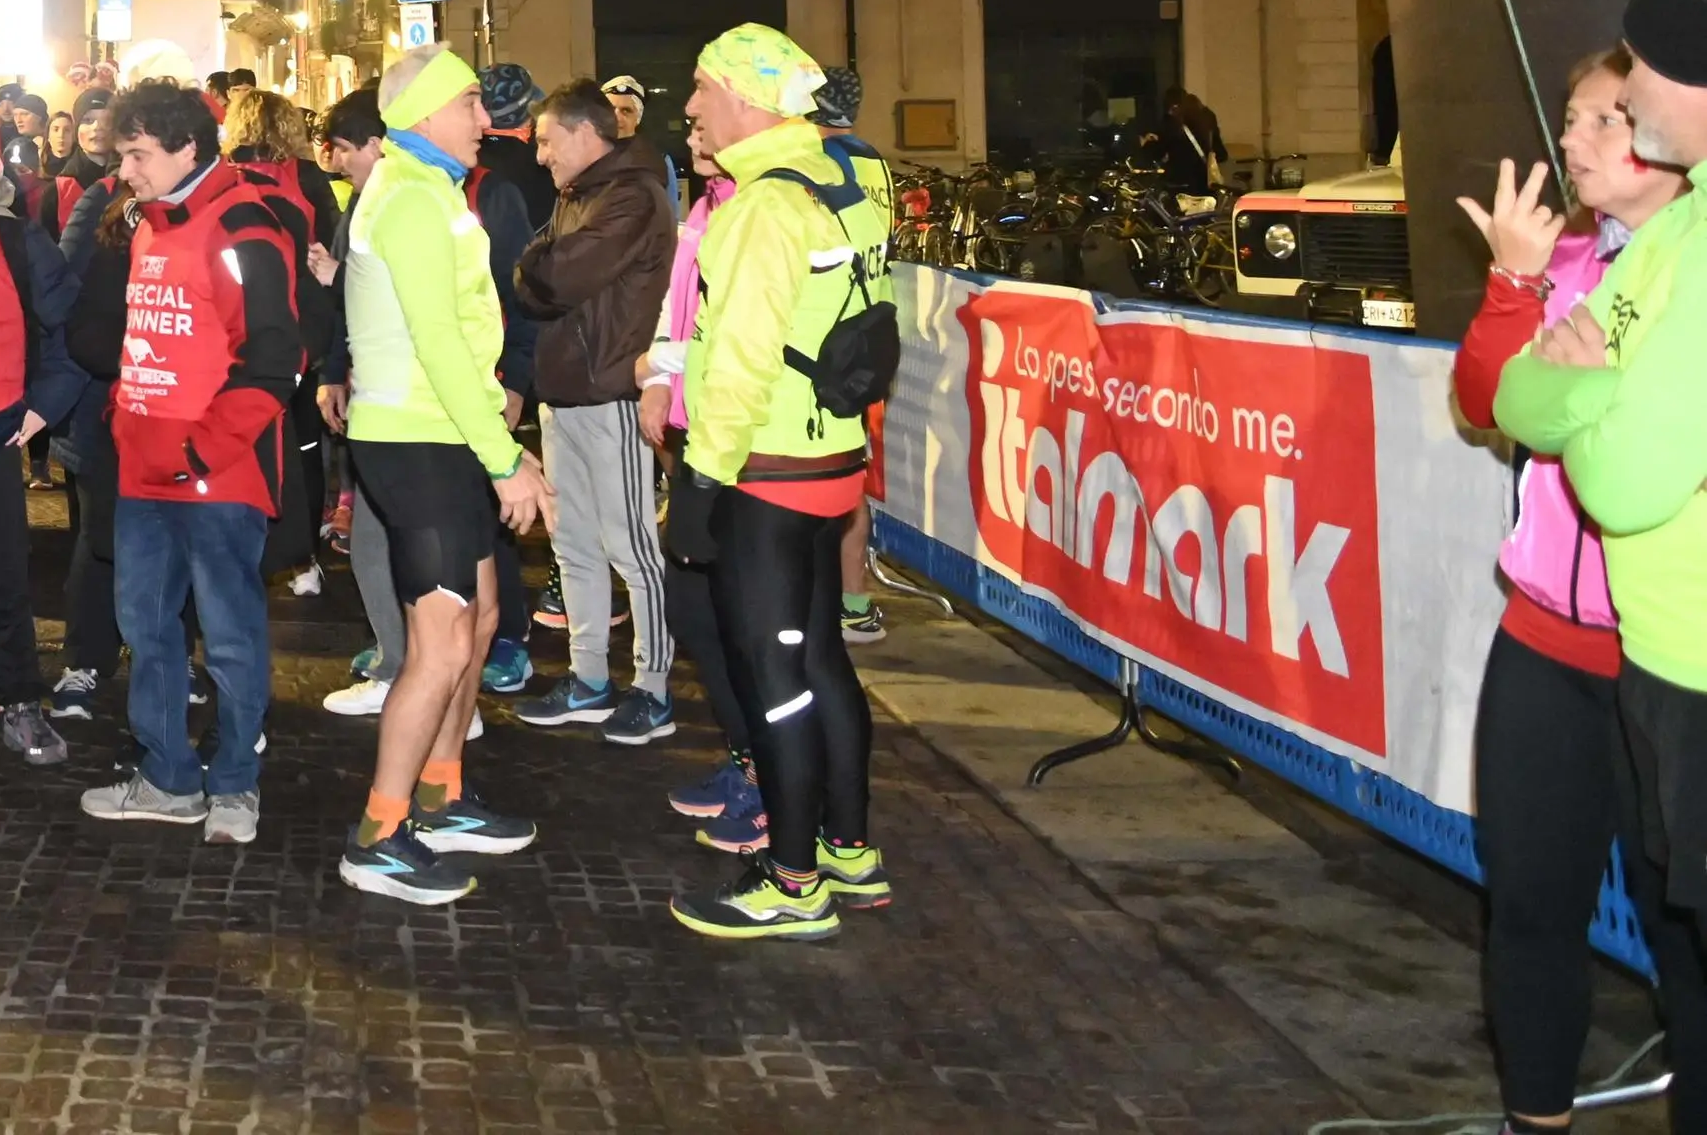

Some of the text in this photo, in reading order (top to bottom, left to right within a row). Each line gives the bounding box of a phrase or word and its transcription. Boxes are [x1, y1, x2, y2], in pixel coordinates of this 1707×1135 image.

[979, 317, 1352, 680] italmark
[1102, 367, 1219, 444] secondo
[1231, 406, 1303, 461] me.
